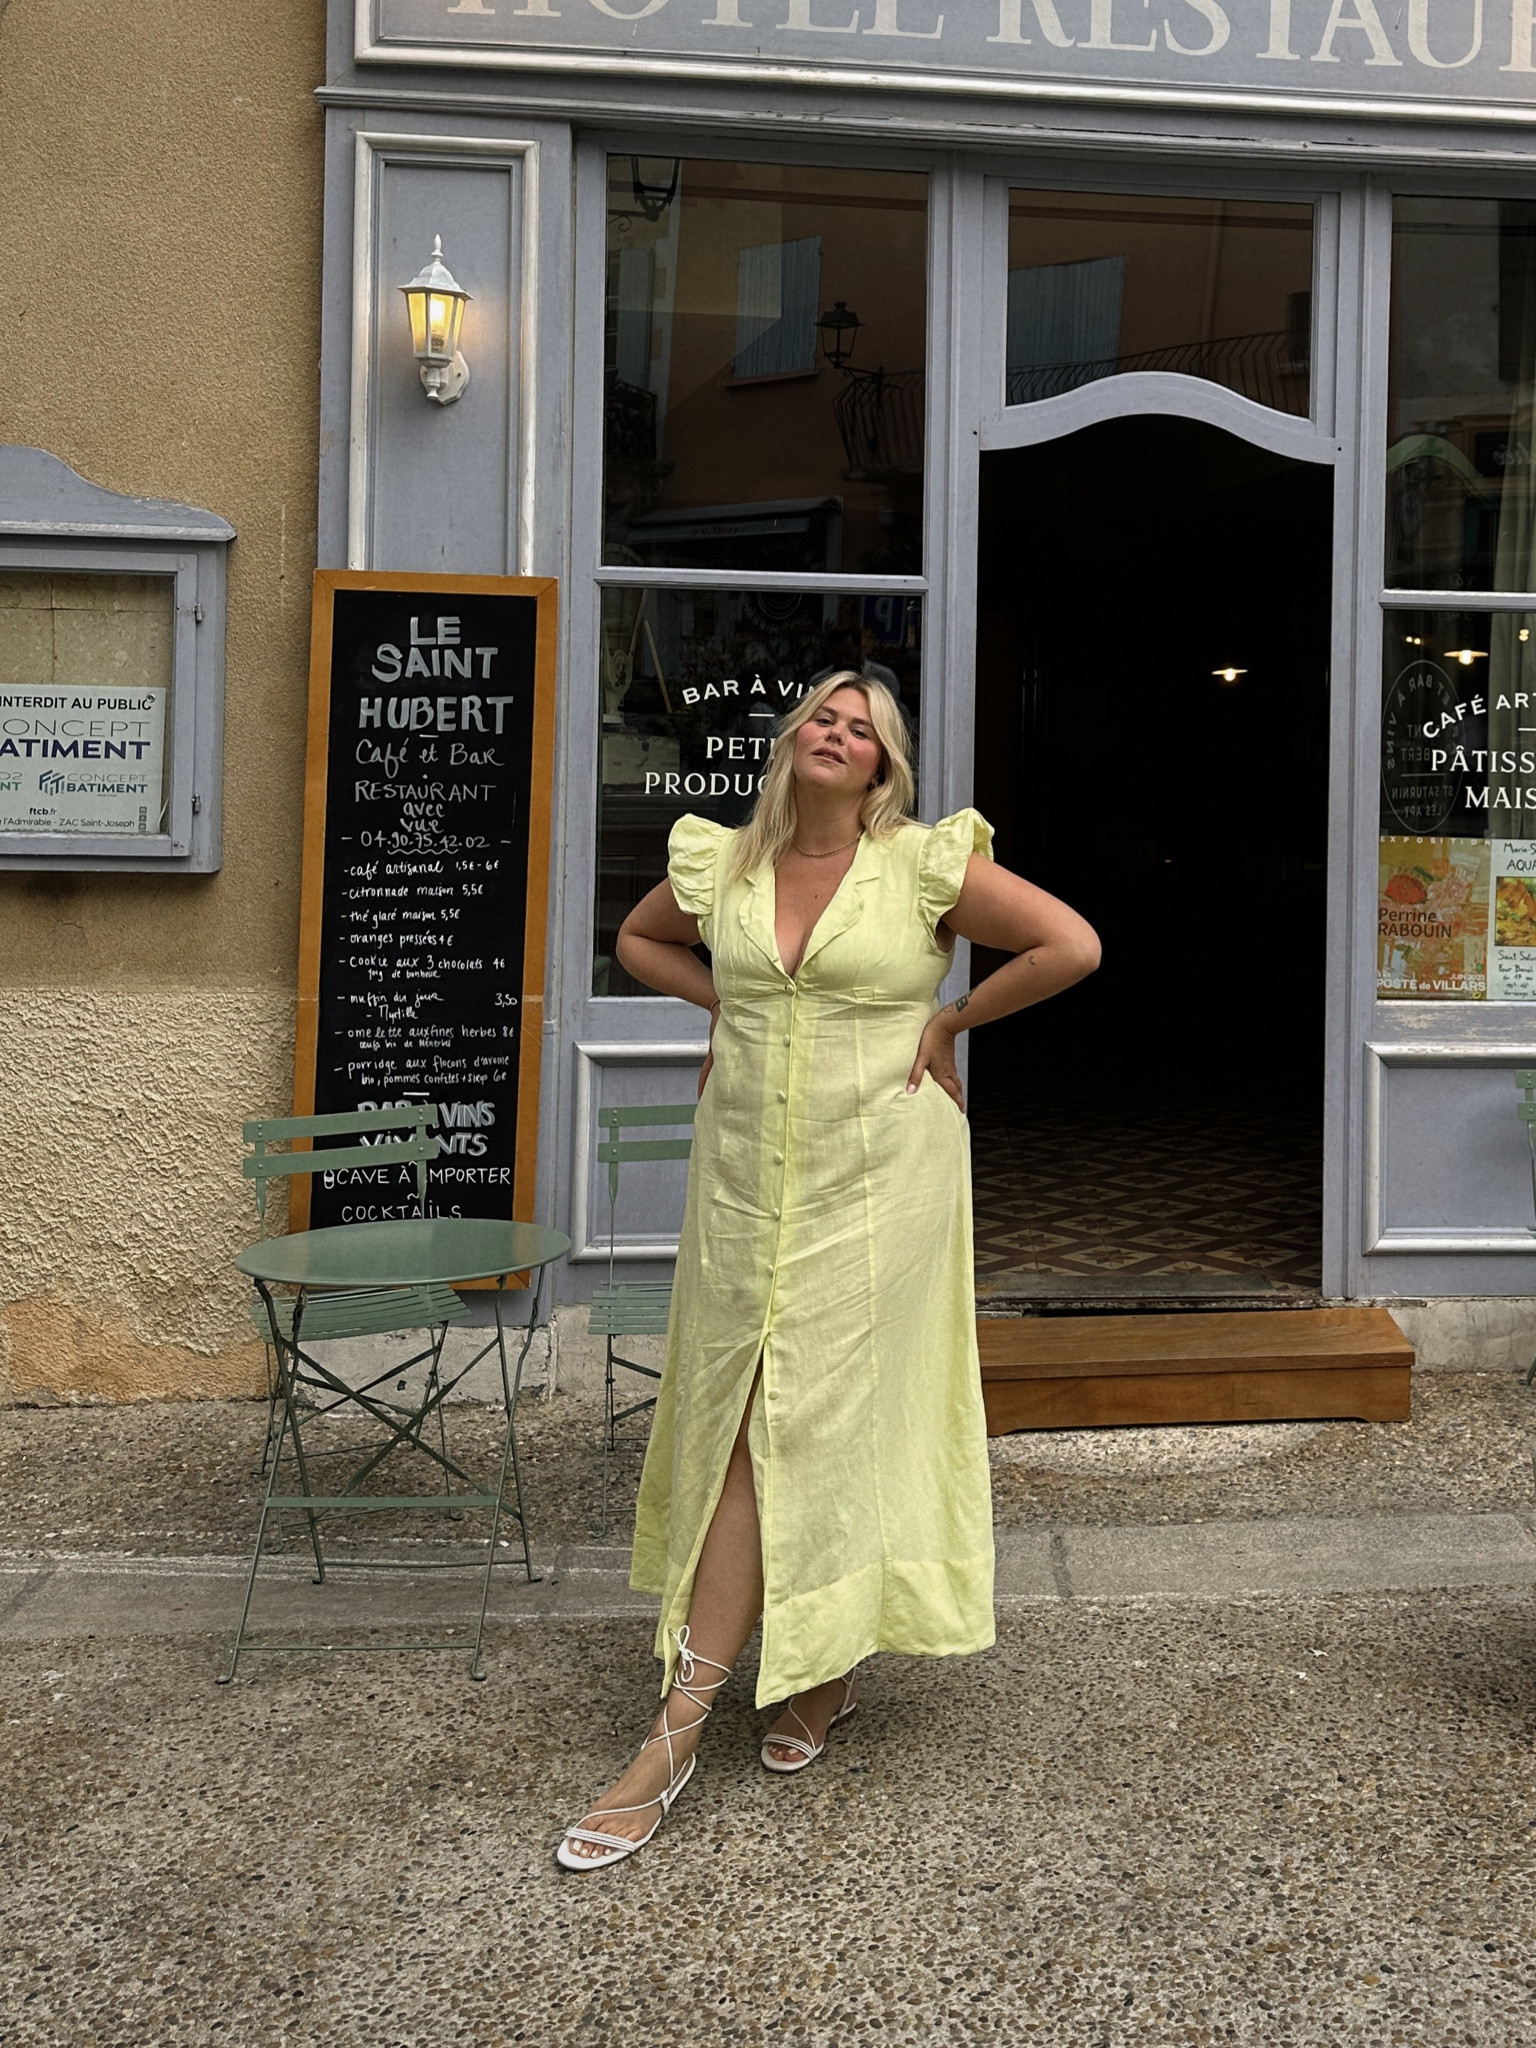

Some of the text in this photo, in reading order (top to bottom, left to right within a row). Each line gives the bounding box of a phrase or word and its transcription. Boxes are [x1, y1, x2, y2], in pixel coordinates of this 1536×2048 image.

[986, 0, 1536, 71] STAU
[410, 616, 461, 645] LE
[371, 643, 498, 683] SAINT
[682, 679, 739, 705] BAR
[750, 673, 767, 695] À
[71, 698, 92, 709] AU
[97, 698, 152, 711] PUBLIC
[358, 695, 513, 735] HUBERT
[1422, 694, 1487, 738] CAFÉ
[1495, 692, 1536, 710] AR
[355, 737, 409, 779] Café
[419, 743, 439, 763] et
[1431, 745, 1536, 774] PÂTISS
[67, 772, 148, 783] CONCEPT
[66, 782, 148, 794] BATIMENT
[355, 780, 498, 803] RESTAURANT
[1465, 786, 1536, 810] MAIS
[29, 806, 57, 815] ftcb.fr
[403, 802, 445, 818] avec
[59, 818, 79, 827] ZAC
[80, 818, 135, 828] Saint-Joseph
[400, 818, 445, 834] vue
[386, 860, 444, 876] artisanal
[349, 882, 484, 900] citronnade maison 5,5€
[349, 909, 370, 922] thé
[402, 908, 436, 922] maison
[440, 908, 461, 921] 5,5€
[1378, 907, 1437, 922] Perrine
[1378, 922, 1451, 938] RABOUIN
[350, 933, 394, 949] oranges
[396, 956, 420, 968] aux
[427, 954, 434, 970] 3
[438, 958, 483, 970] chocolats
[492, 957, 506, 970] 4€
[391, 969, 401, 979] de
[1377, 978, 1418, 990] POSTE
[1432, 980, 1486, 992] VILLARS
[393, 991, 407, 1003] du
[494, 993, 518, 1008] 3,50
[461, 1024, 497, 1039] herbes
[502, 1026, 514, 1038] 8€
[404, 1039, 413, 1048] de
[347, 1059, 397, 1080] porridge
[406, 1058, 427, 1069] aux
[433, 1054, 467, 1073] flocons
[383, 1073, 421, 1088] pommes
[336, 1165, 511, 1185] CAVE À MPORTER
